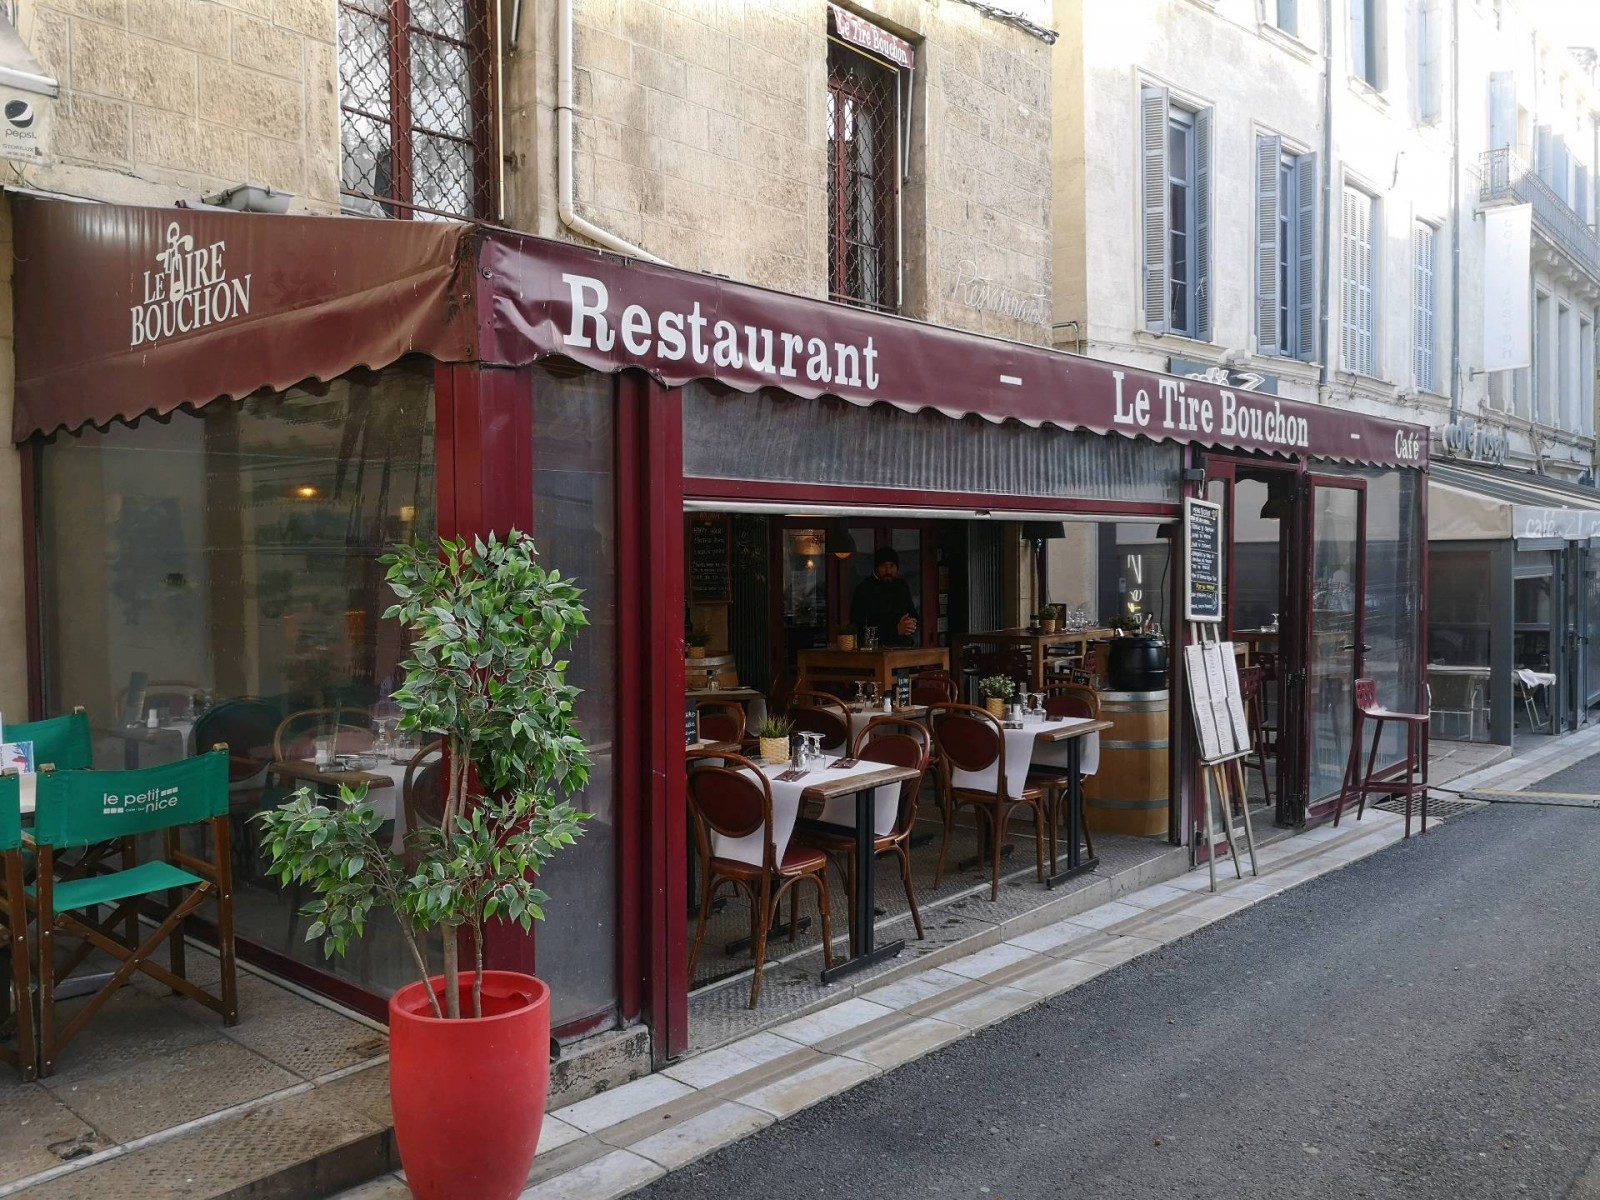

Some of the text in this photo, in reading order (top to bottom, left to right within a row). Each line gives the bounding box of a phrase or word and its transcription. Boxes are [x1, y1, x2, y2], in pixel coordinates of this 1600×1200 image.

[852, 21, 871, 46] Tire
[873, 29, 908, 64] Bouchon
[143, 270, 166, 304] LE
[130, 274, 252, 346] BOUCHON
[562, 272, 880, 391] Restaurant
[1112, 370, 1151, 427] Le
[1158, 379, 1214, 434] Tire
[1219, 390, 1309, 448] Bouchon
[1395, 429, 1420, 460] Café
[103, 787, 160, 807] le petit
[145, 796, 178, 813] nice
